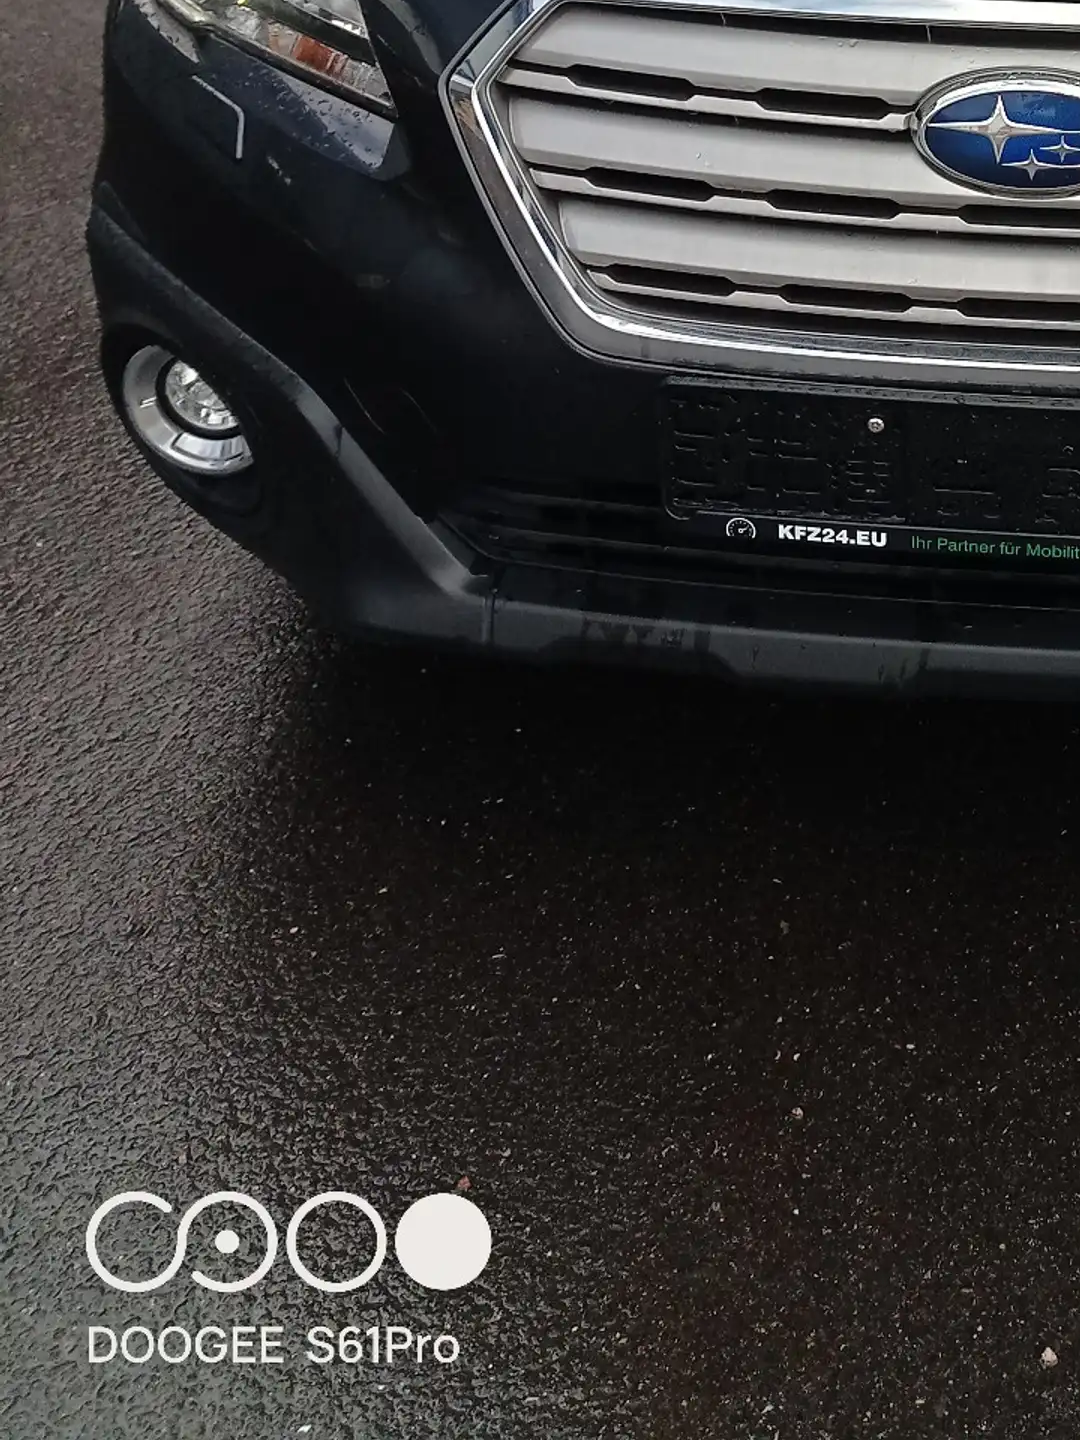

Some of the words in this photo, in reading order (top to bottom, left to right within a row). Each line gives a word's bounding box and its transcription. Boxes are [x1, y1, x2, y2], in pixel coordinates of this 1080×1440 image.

[778, 524, 887, 548] KFZ24.EU
[911, 535, 932, 550] Ihr
[937, 537, 995, 554] Partner
[998, 541, 1021, 556] für
